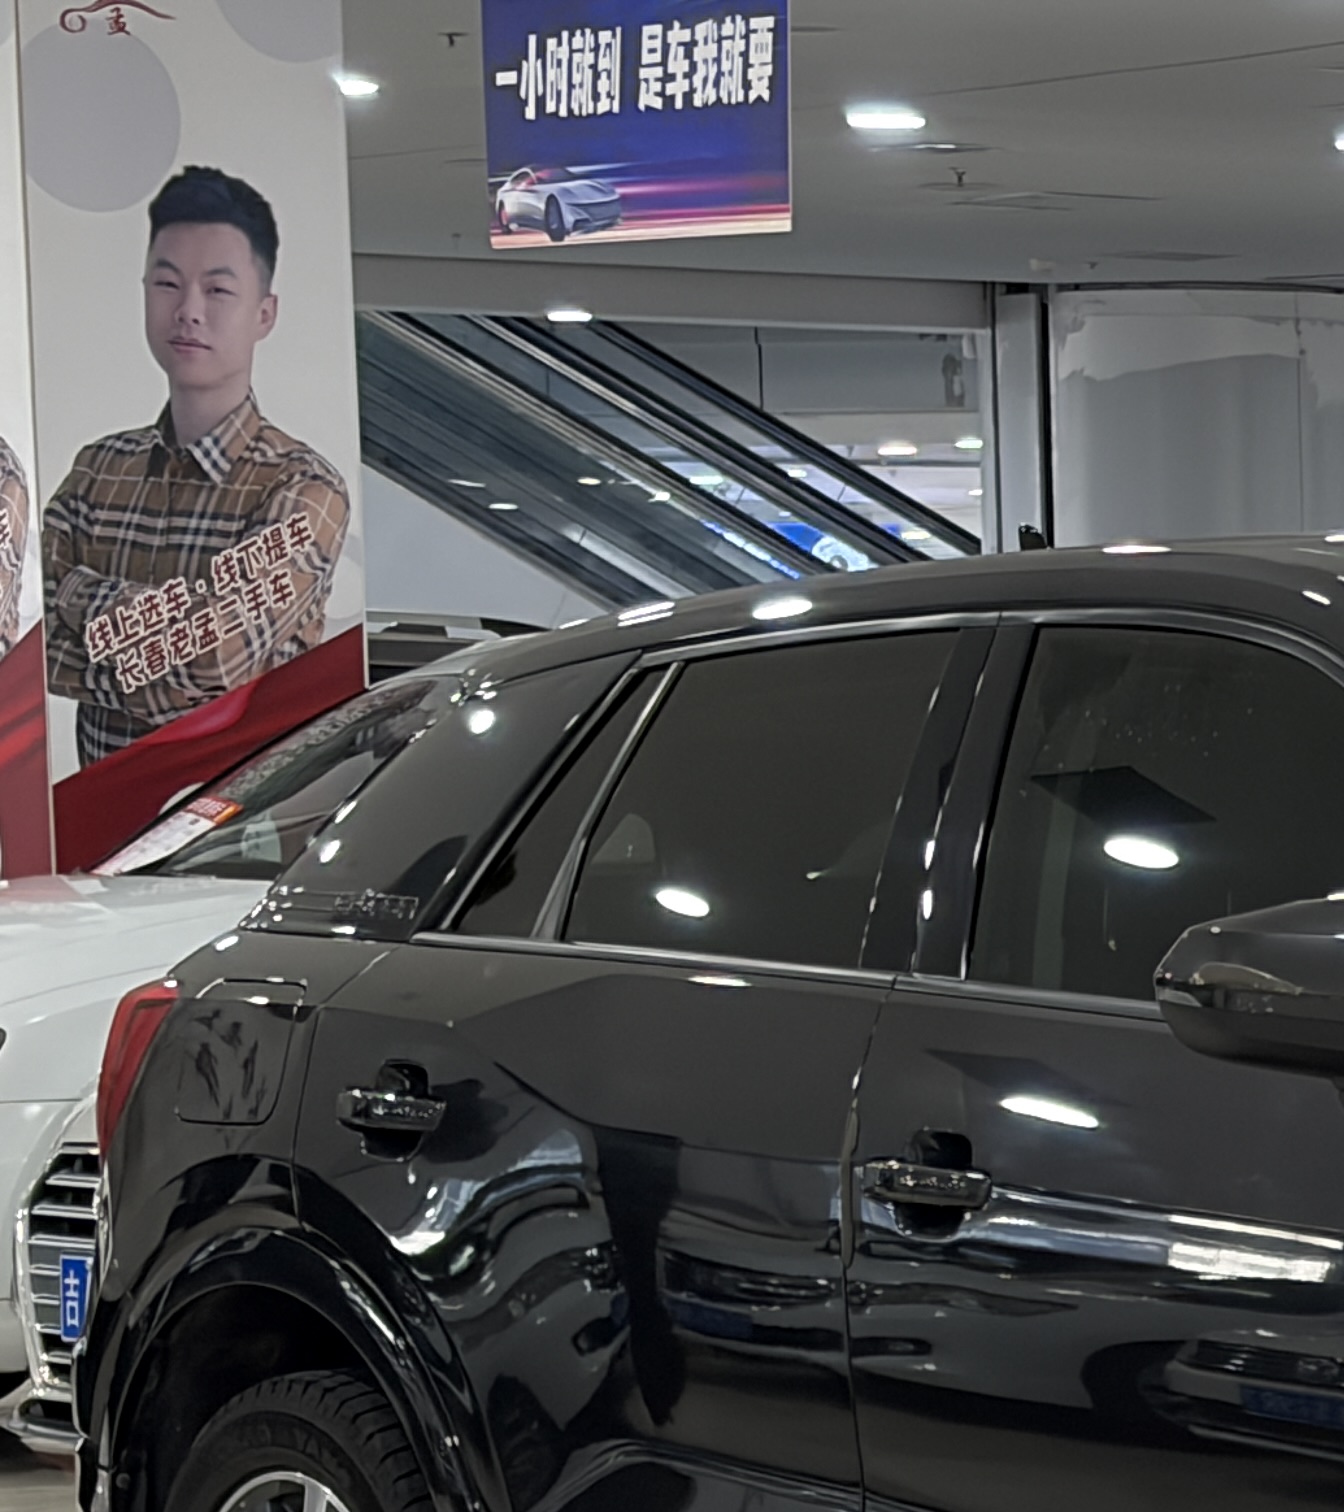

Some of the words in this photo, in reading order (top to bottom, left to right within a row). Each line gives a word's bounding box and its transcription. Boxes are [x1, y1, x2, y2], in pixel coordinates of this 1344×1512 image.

[495, 26, 622, 120] 一小时就到
[637, 14, 775, 112] 是车我就要
[116, 569, 296, 694] 长春老孟二手车
